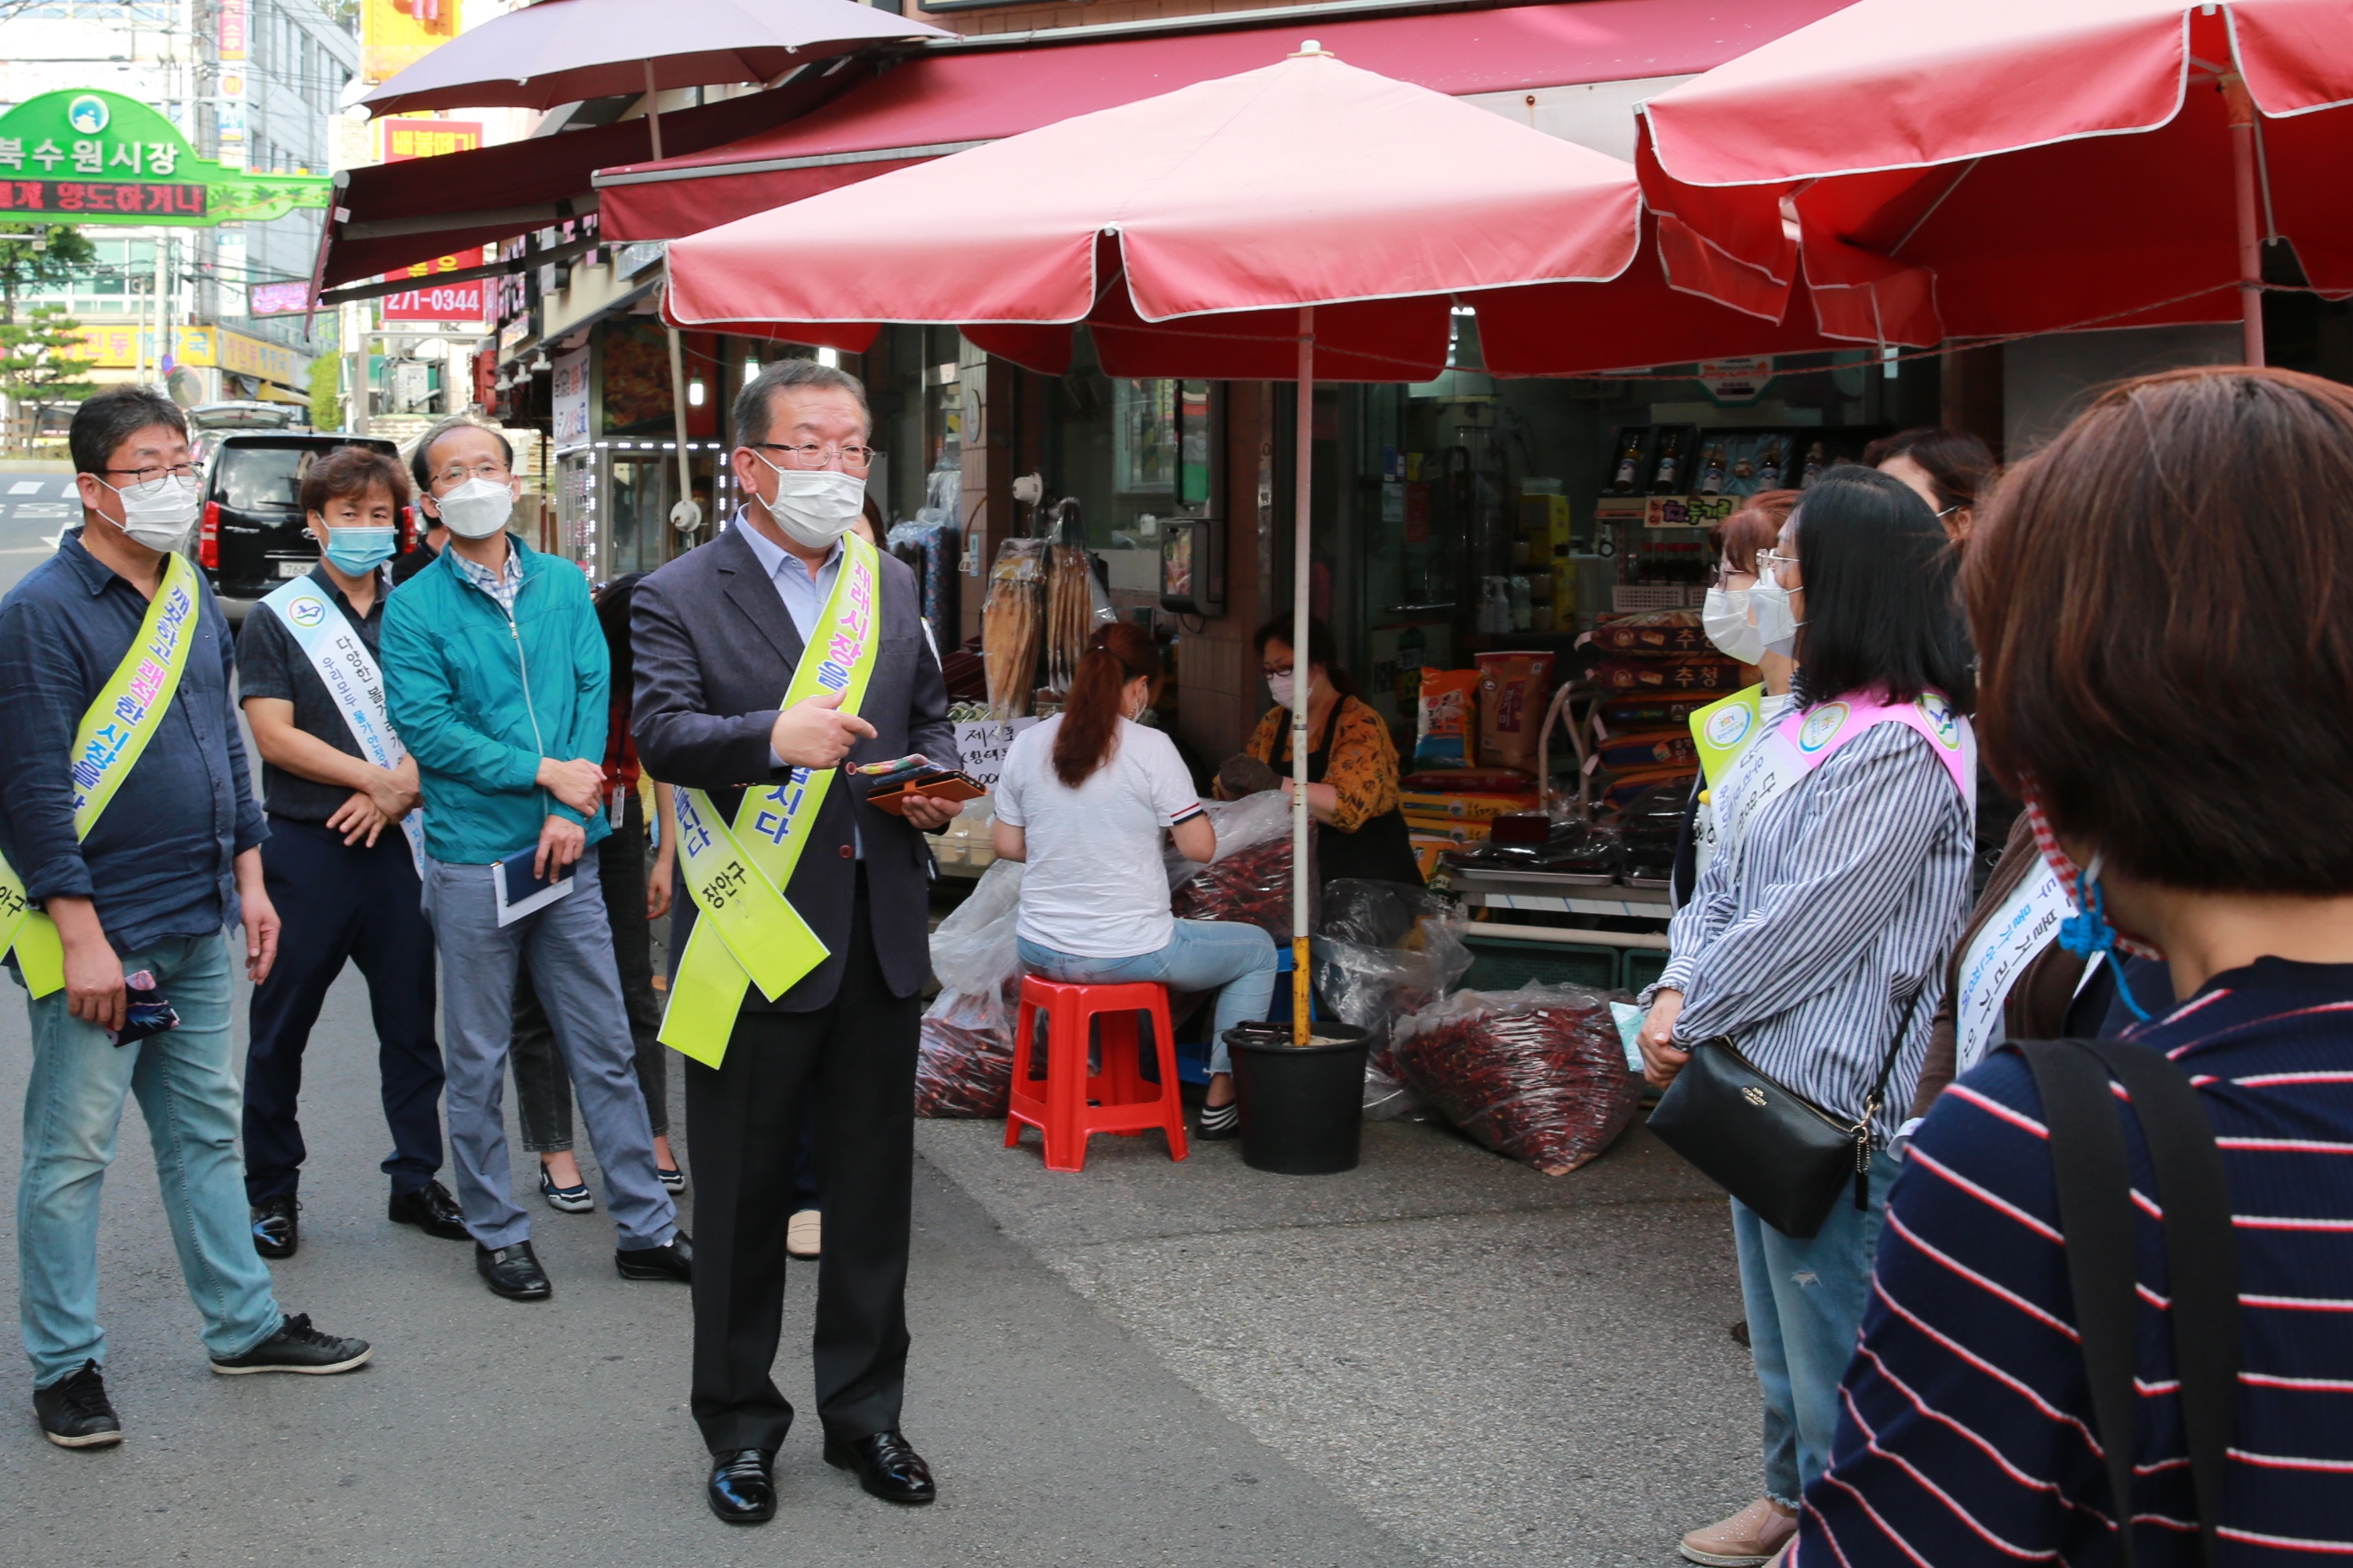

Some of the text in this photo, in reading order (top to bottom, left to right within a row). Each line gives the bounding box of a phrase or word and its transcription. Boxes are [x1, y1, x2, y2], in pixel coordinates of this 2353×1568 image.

[0, 137, 180, 175] 북수원시장
[387, 289, 480, 312] 271-0344
[148, 585, 191, 667] 깨끗하고
[817, 561, 872, 693] 재래시장을
[322, 657, 358, 707] 우리모두
[336, 635, 373, 684] 다양한
[1674, 666, 1720, 689] 추청
[114, 657, 168, 728] 쾌적한
[1498, 689, 1513, 728] 경기미
[702, 860, 748, 910] 장안구
[1962, 903, 2032, 1018] 물가안정에
[1979, 908, 2059, 1025] 볼거리가
